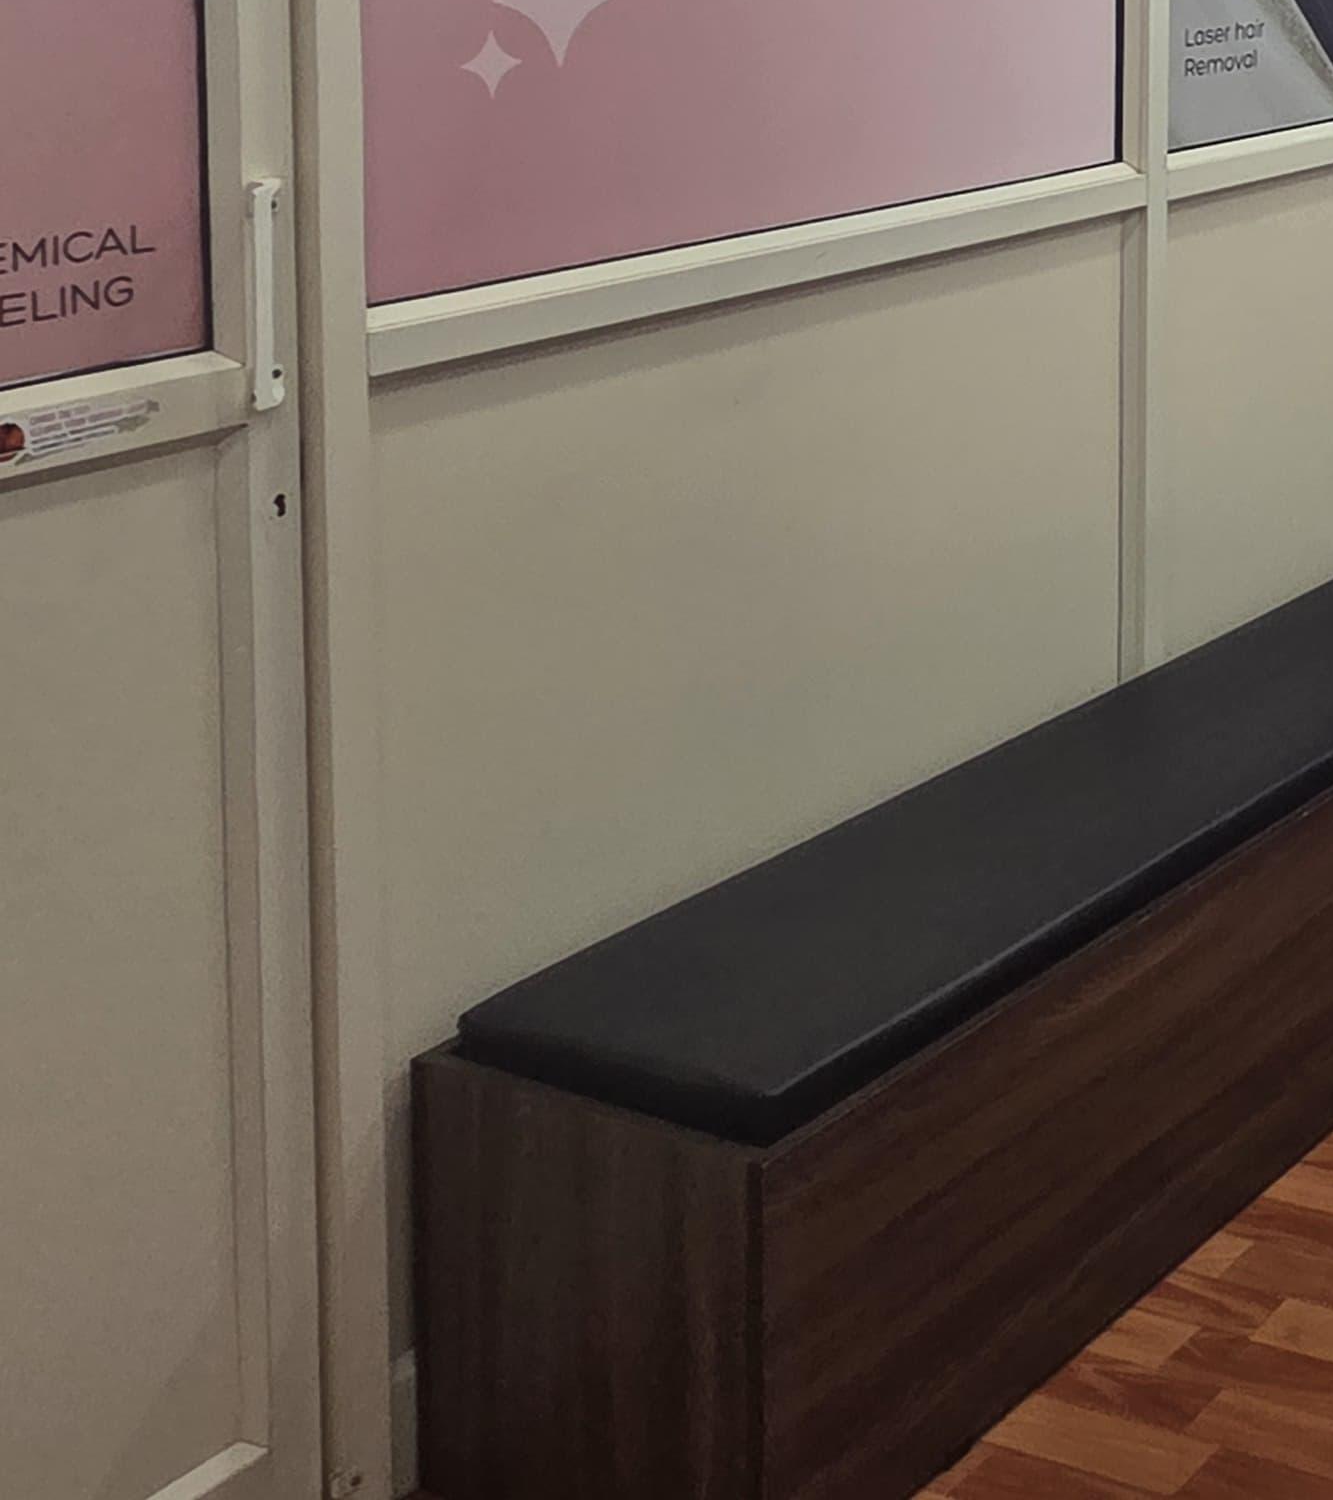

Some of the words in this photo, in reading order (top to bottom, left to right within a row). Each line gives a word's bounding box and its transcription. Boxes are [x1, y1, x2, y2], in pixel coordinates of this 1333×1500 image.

[1185, 26, 1231, 48] Laser
[1235, 19, 1265, 41] hair
[1184, 50, 1259, 77] Removal
